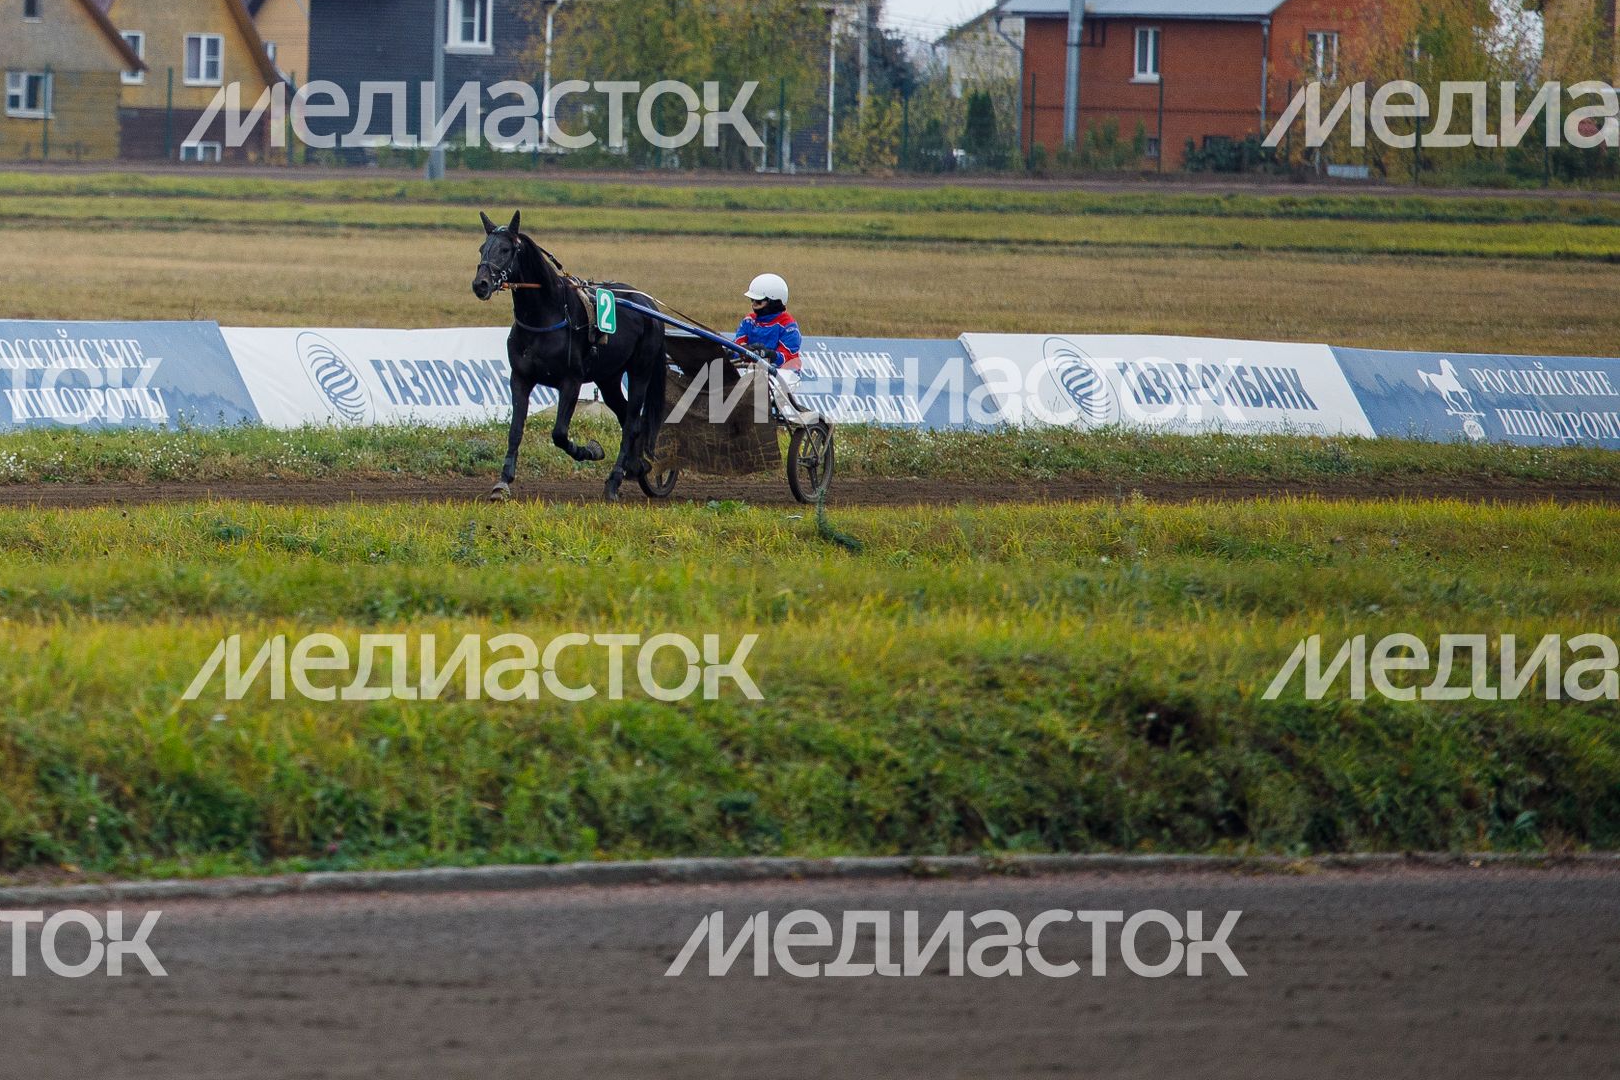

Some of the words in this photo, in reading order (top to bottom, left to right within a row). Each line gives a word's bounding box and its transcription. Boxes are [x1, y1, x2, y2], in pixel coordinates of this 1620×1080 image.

[600, 293, 612, 330] 2
[1114, 361, 1319, 411] ГАЗПРОМБАНК
[1469, 361, 1619, 396] РОССИЙСКИЕ
[3, 387, 170, 424] ИППОДРОМЫ
